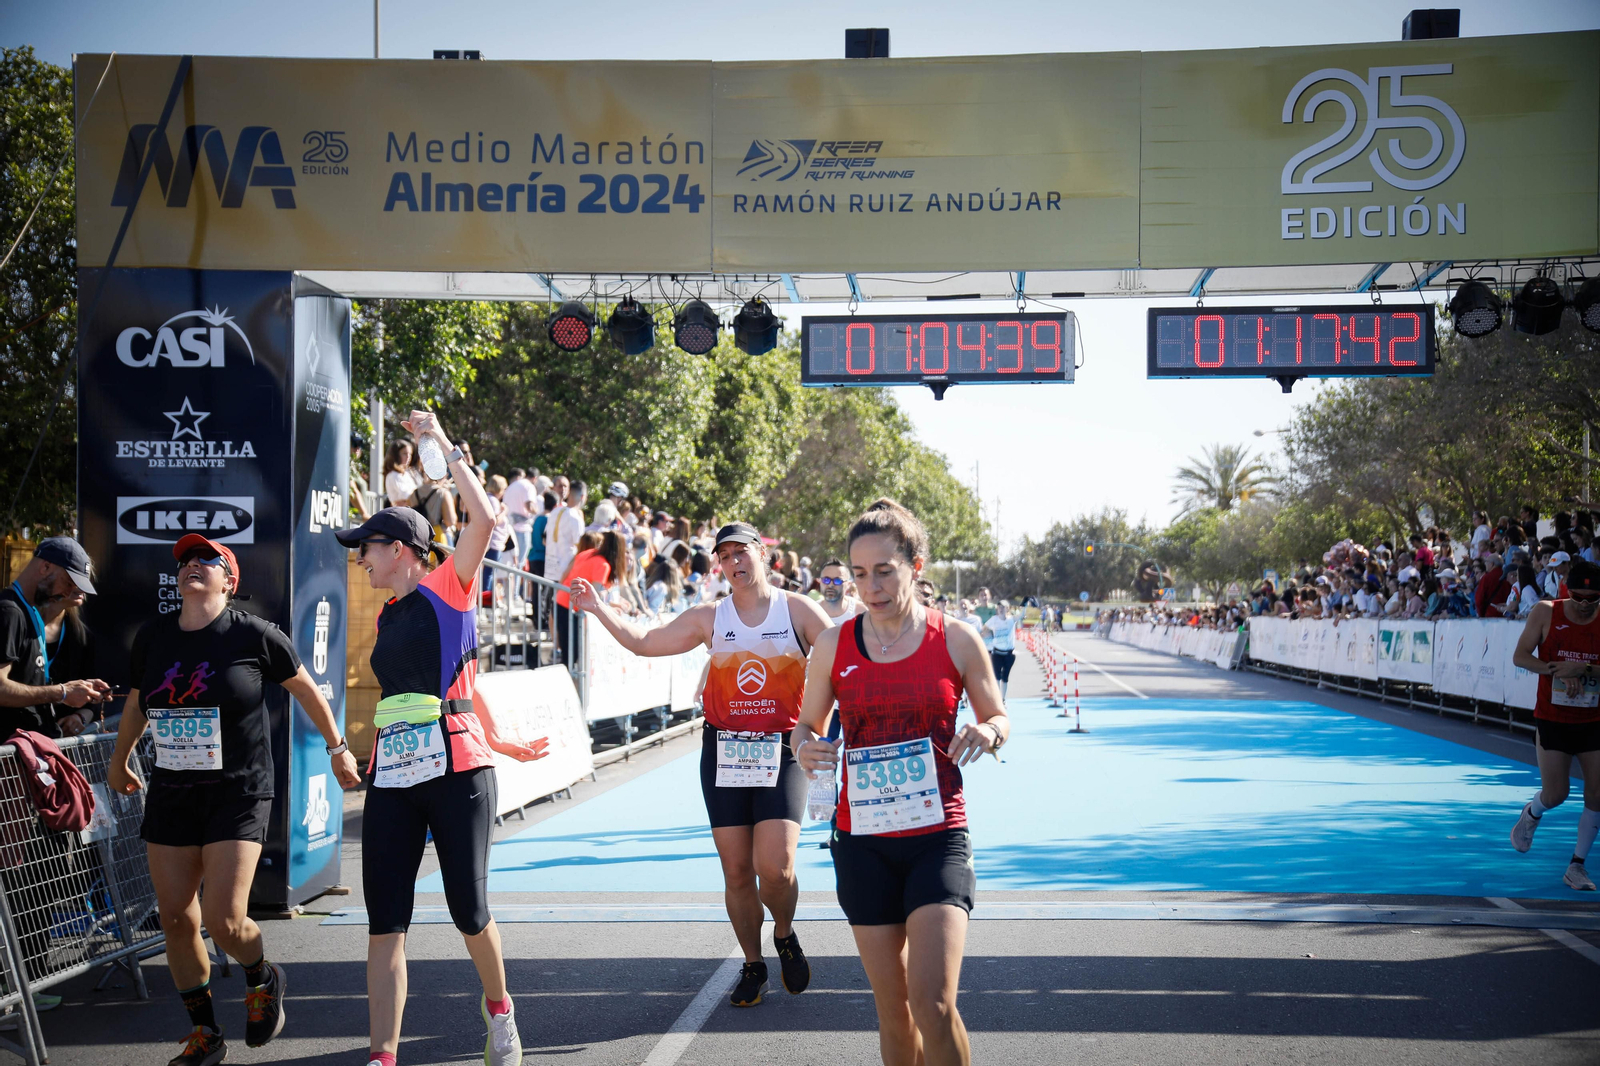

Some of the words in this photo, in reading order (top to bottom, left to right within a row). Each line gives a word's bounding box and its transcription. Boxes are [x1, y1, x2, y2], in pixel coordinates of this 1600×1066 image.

[1281, 63, 1466, 195] 25
[302, 131, 349, 163] 25
[385, 132, 511, 163] Medio
[531, 133, 705, 165] Maratón
[817, 141, 883, 157] RFEA
[302, 164, 349, 176] EDICIÓN
[810, 157, 877, 170] SERIES
[804, 170, 847, 182] RUTA
[850, 170, 916, 182] RUNNING
[383, 172, 566, 213] Almería
[577, 174, 705, 213] 2024
[733, 190, 836, 213] RAMÓN
[849, 193, 914, 213] RUIZ
[926, 187, 1062, 212] ANDÚJAR
[1281, 196, 1466, 240] EDICIÓN
[115, 326, 226, 368] CASI
[845, 321, 1061, 375] 01:04:39
[1194, 312, 1421, 368] 01:17:42
[115, 440, 258, 458] ESTRELLA
[148, 458, 166, 468] DE
[167, 458, 226, 468] LEVANTE
[136, 510, 239, 530] IKEA
[1557, 650, 1582, 659] ATHLETIC
[1582, 652, 1600, 661] TRACK
[156, 717, 213, 738] 5695
[382, 725, 433, 758] 5697
[724, 741, 775, 760] 5069
[399, 751, 415, 760] ALMU
[855, 755, 926, 790] 5389
[879, 786, 900, 795] LOLA
